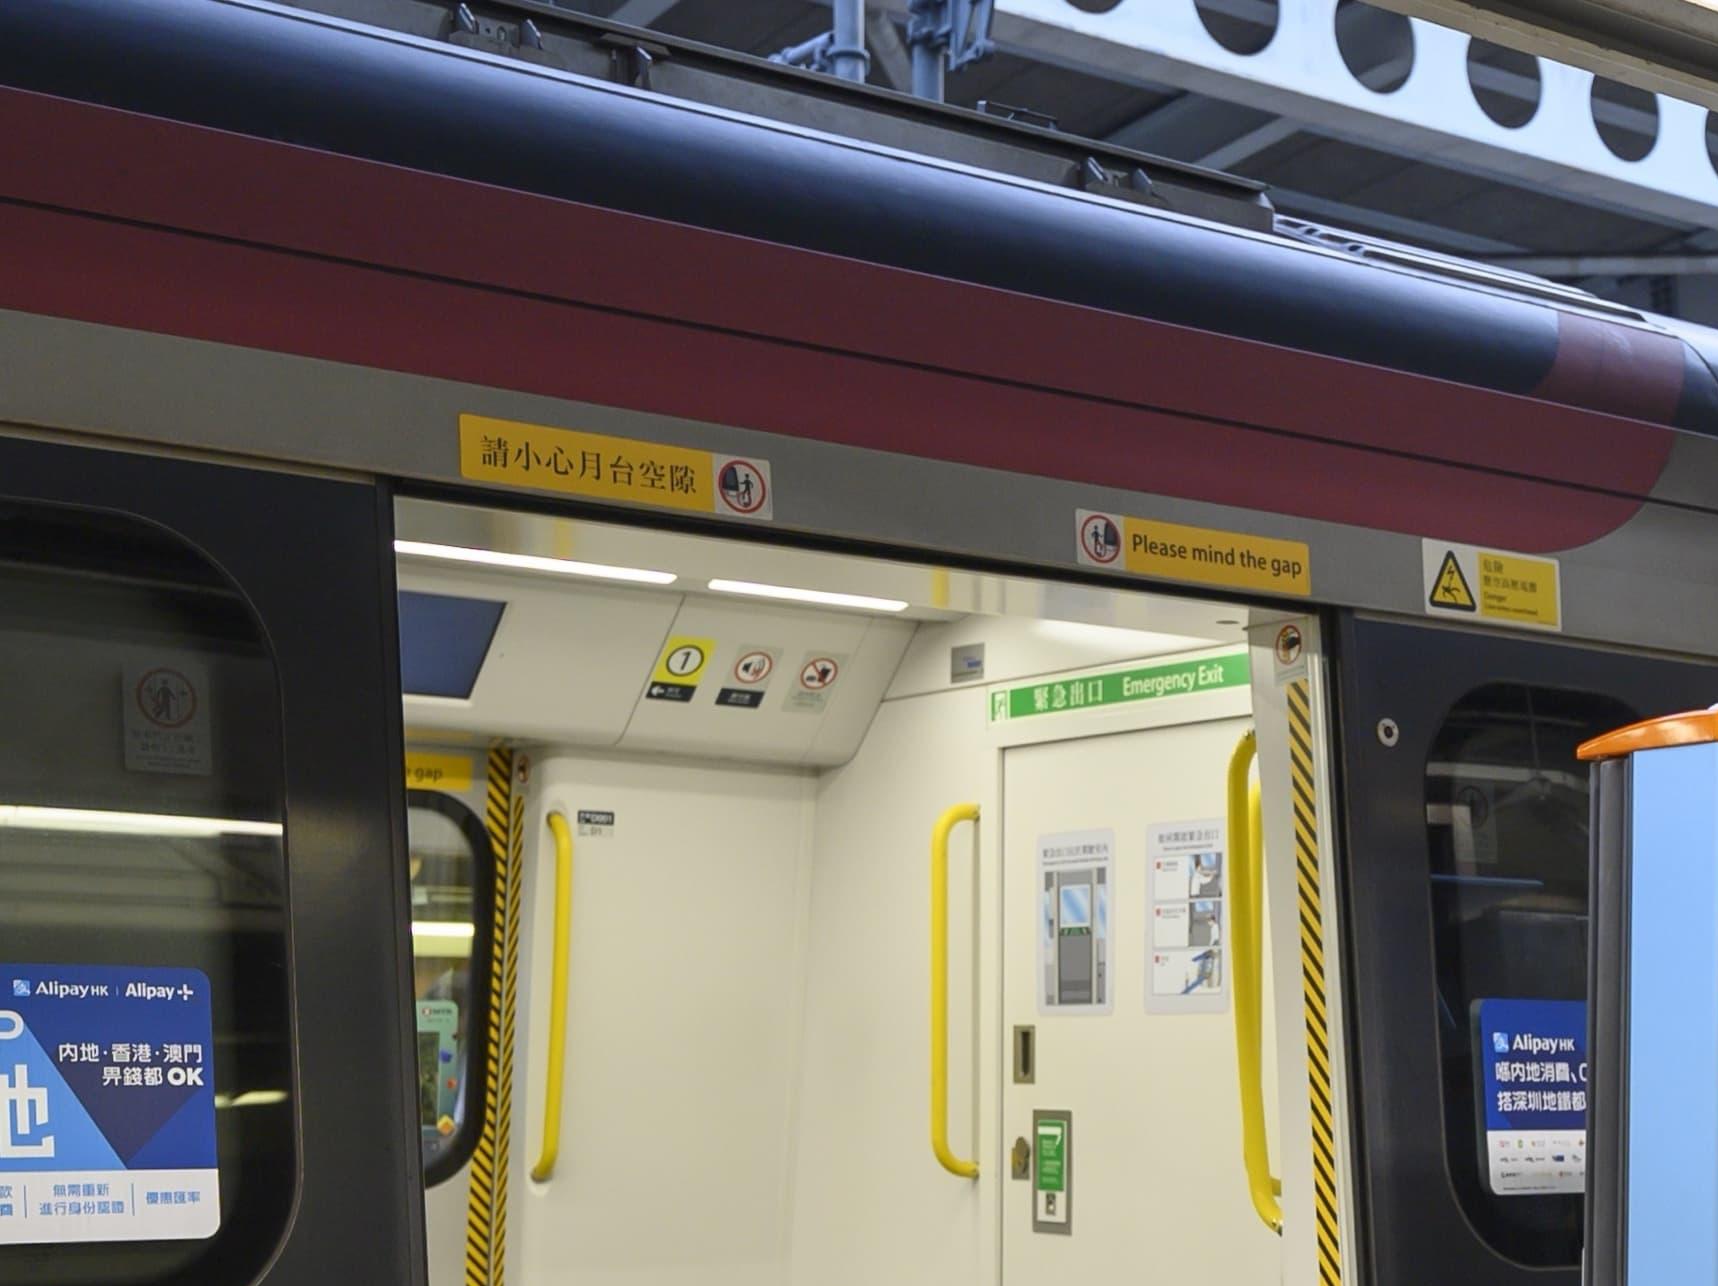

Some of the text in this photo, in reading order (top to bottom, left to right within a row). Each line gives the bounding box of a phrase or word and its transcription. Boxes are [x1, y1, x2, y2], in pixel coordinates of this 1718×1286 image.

[480, 435, 697, 495] 請小心月台空隙
[1132, 533, 1302, 579] Please mind the gap
[679, 650, 692, 671] 1
[1123, 664, 1225, 698] Emergency Exit
[1033, 679, 1103, 712] 緊急出口
[414, 767, 445, 784] gap
[1512, 1033, 1575, 1055] AlipayHK
[167, 1067, 205, 1086] OK
